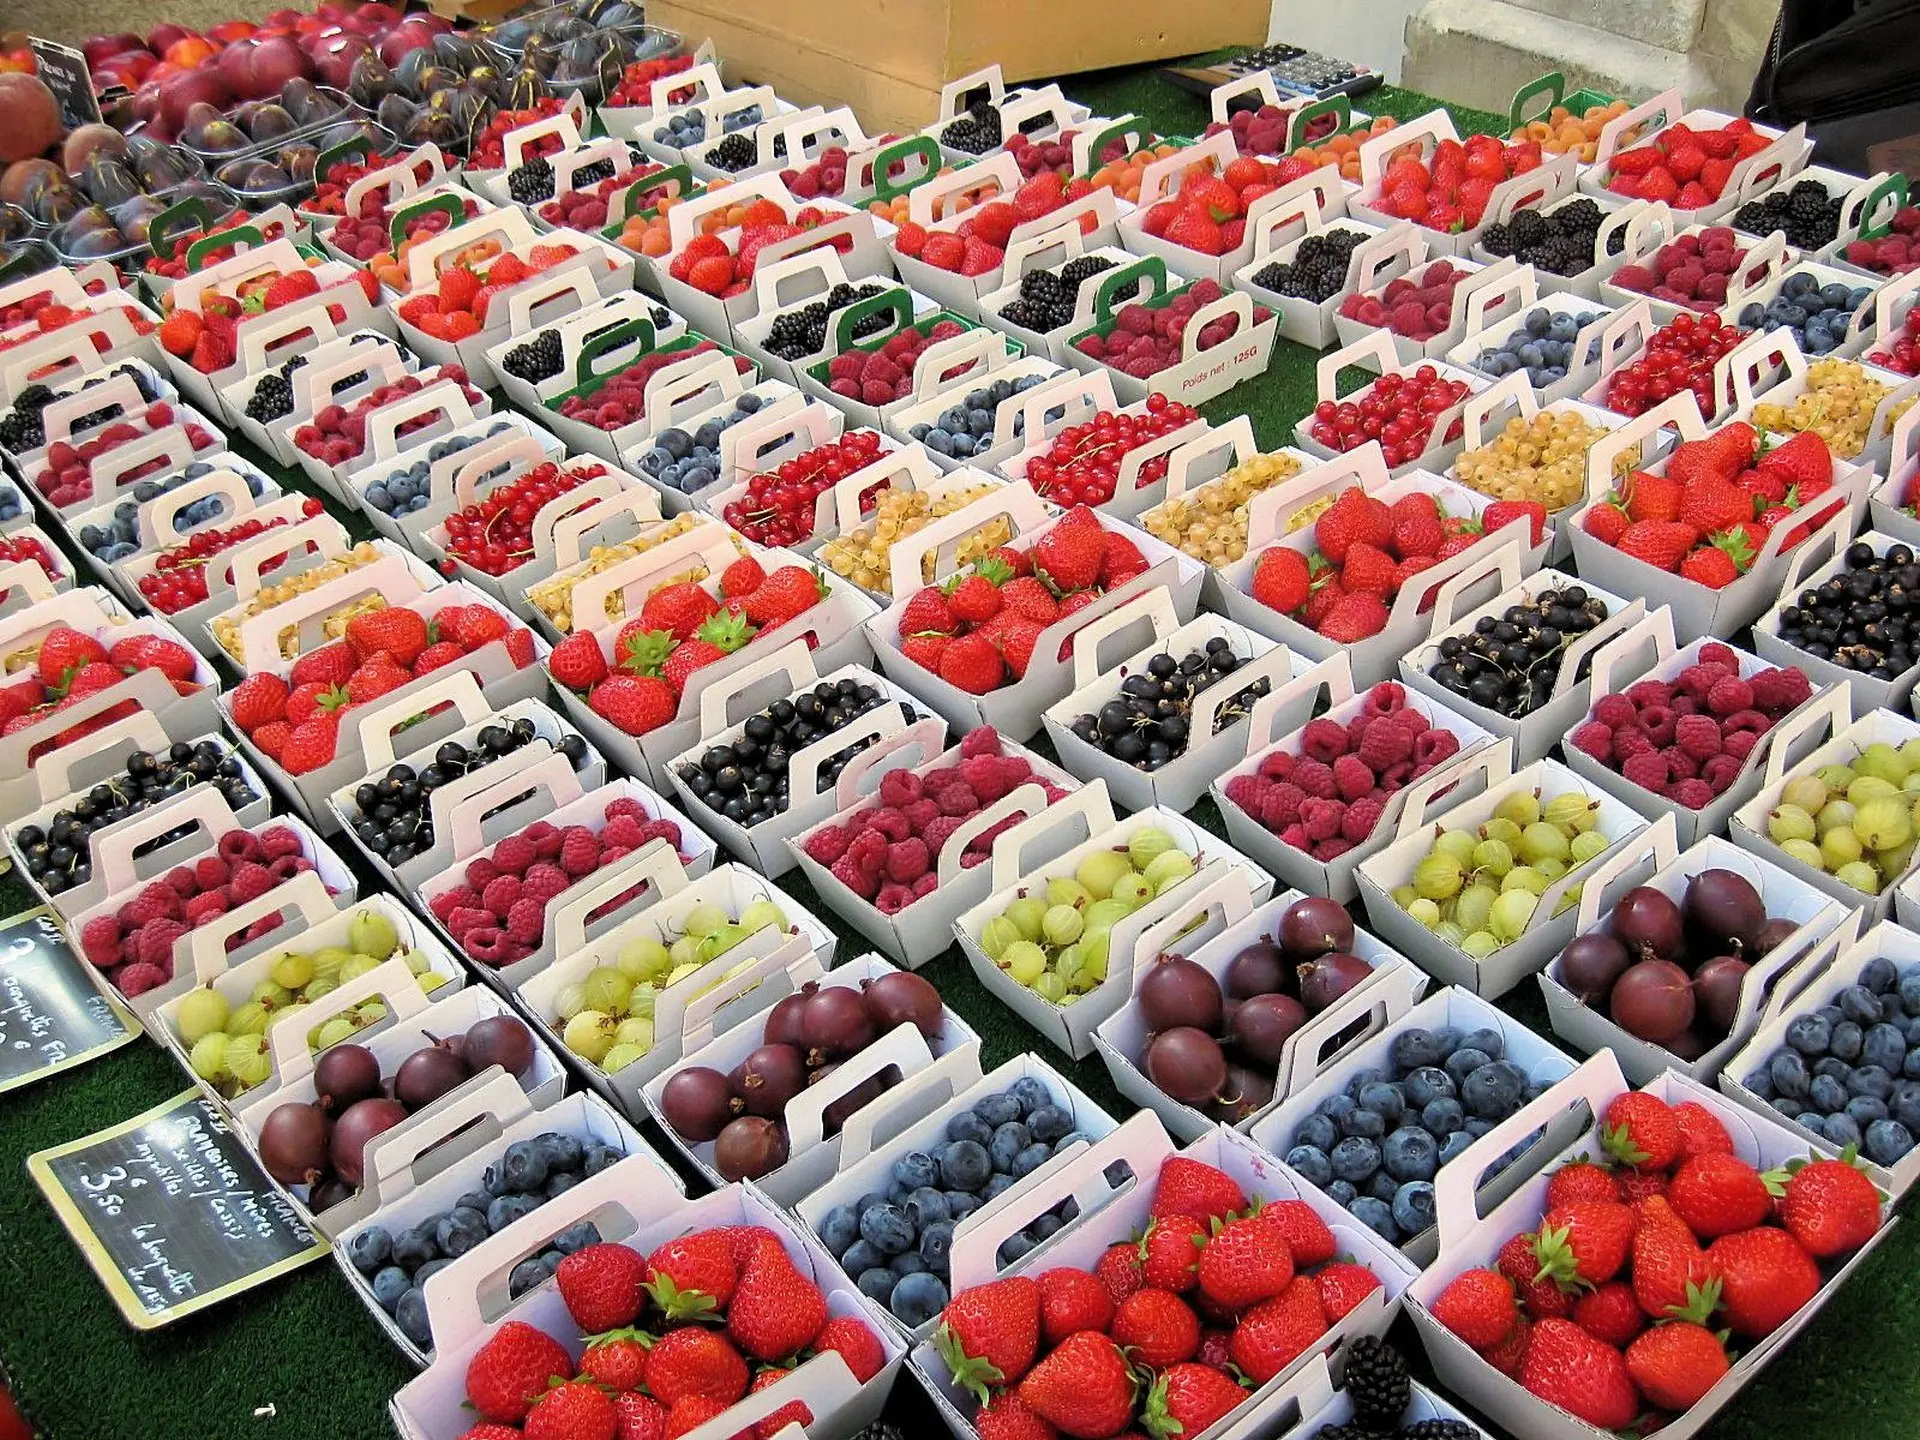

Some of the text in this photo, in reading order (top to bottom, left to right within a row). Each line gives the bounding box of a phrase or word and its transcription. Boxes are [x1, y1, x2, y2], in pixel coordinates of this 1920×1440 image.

[1181, 372, 1208, 391] Poids
[1209, 362, 1225, 378] net
[1233, 345, 1258, 365] 125G
